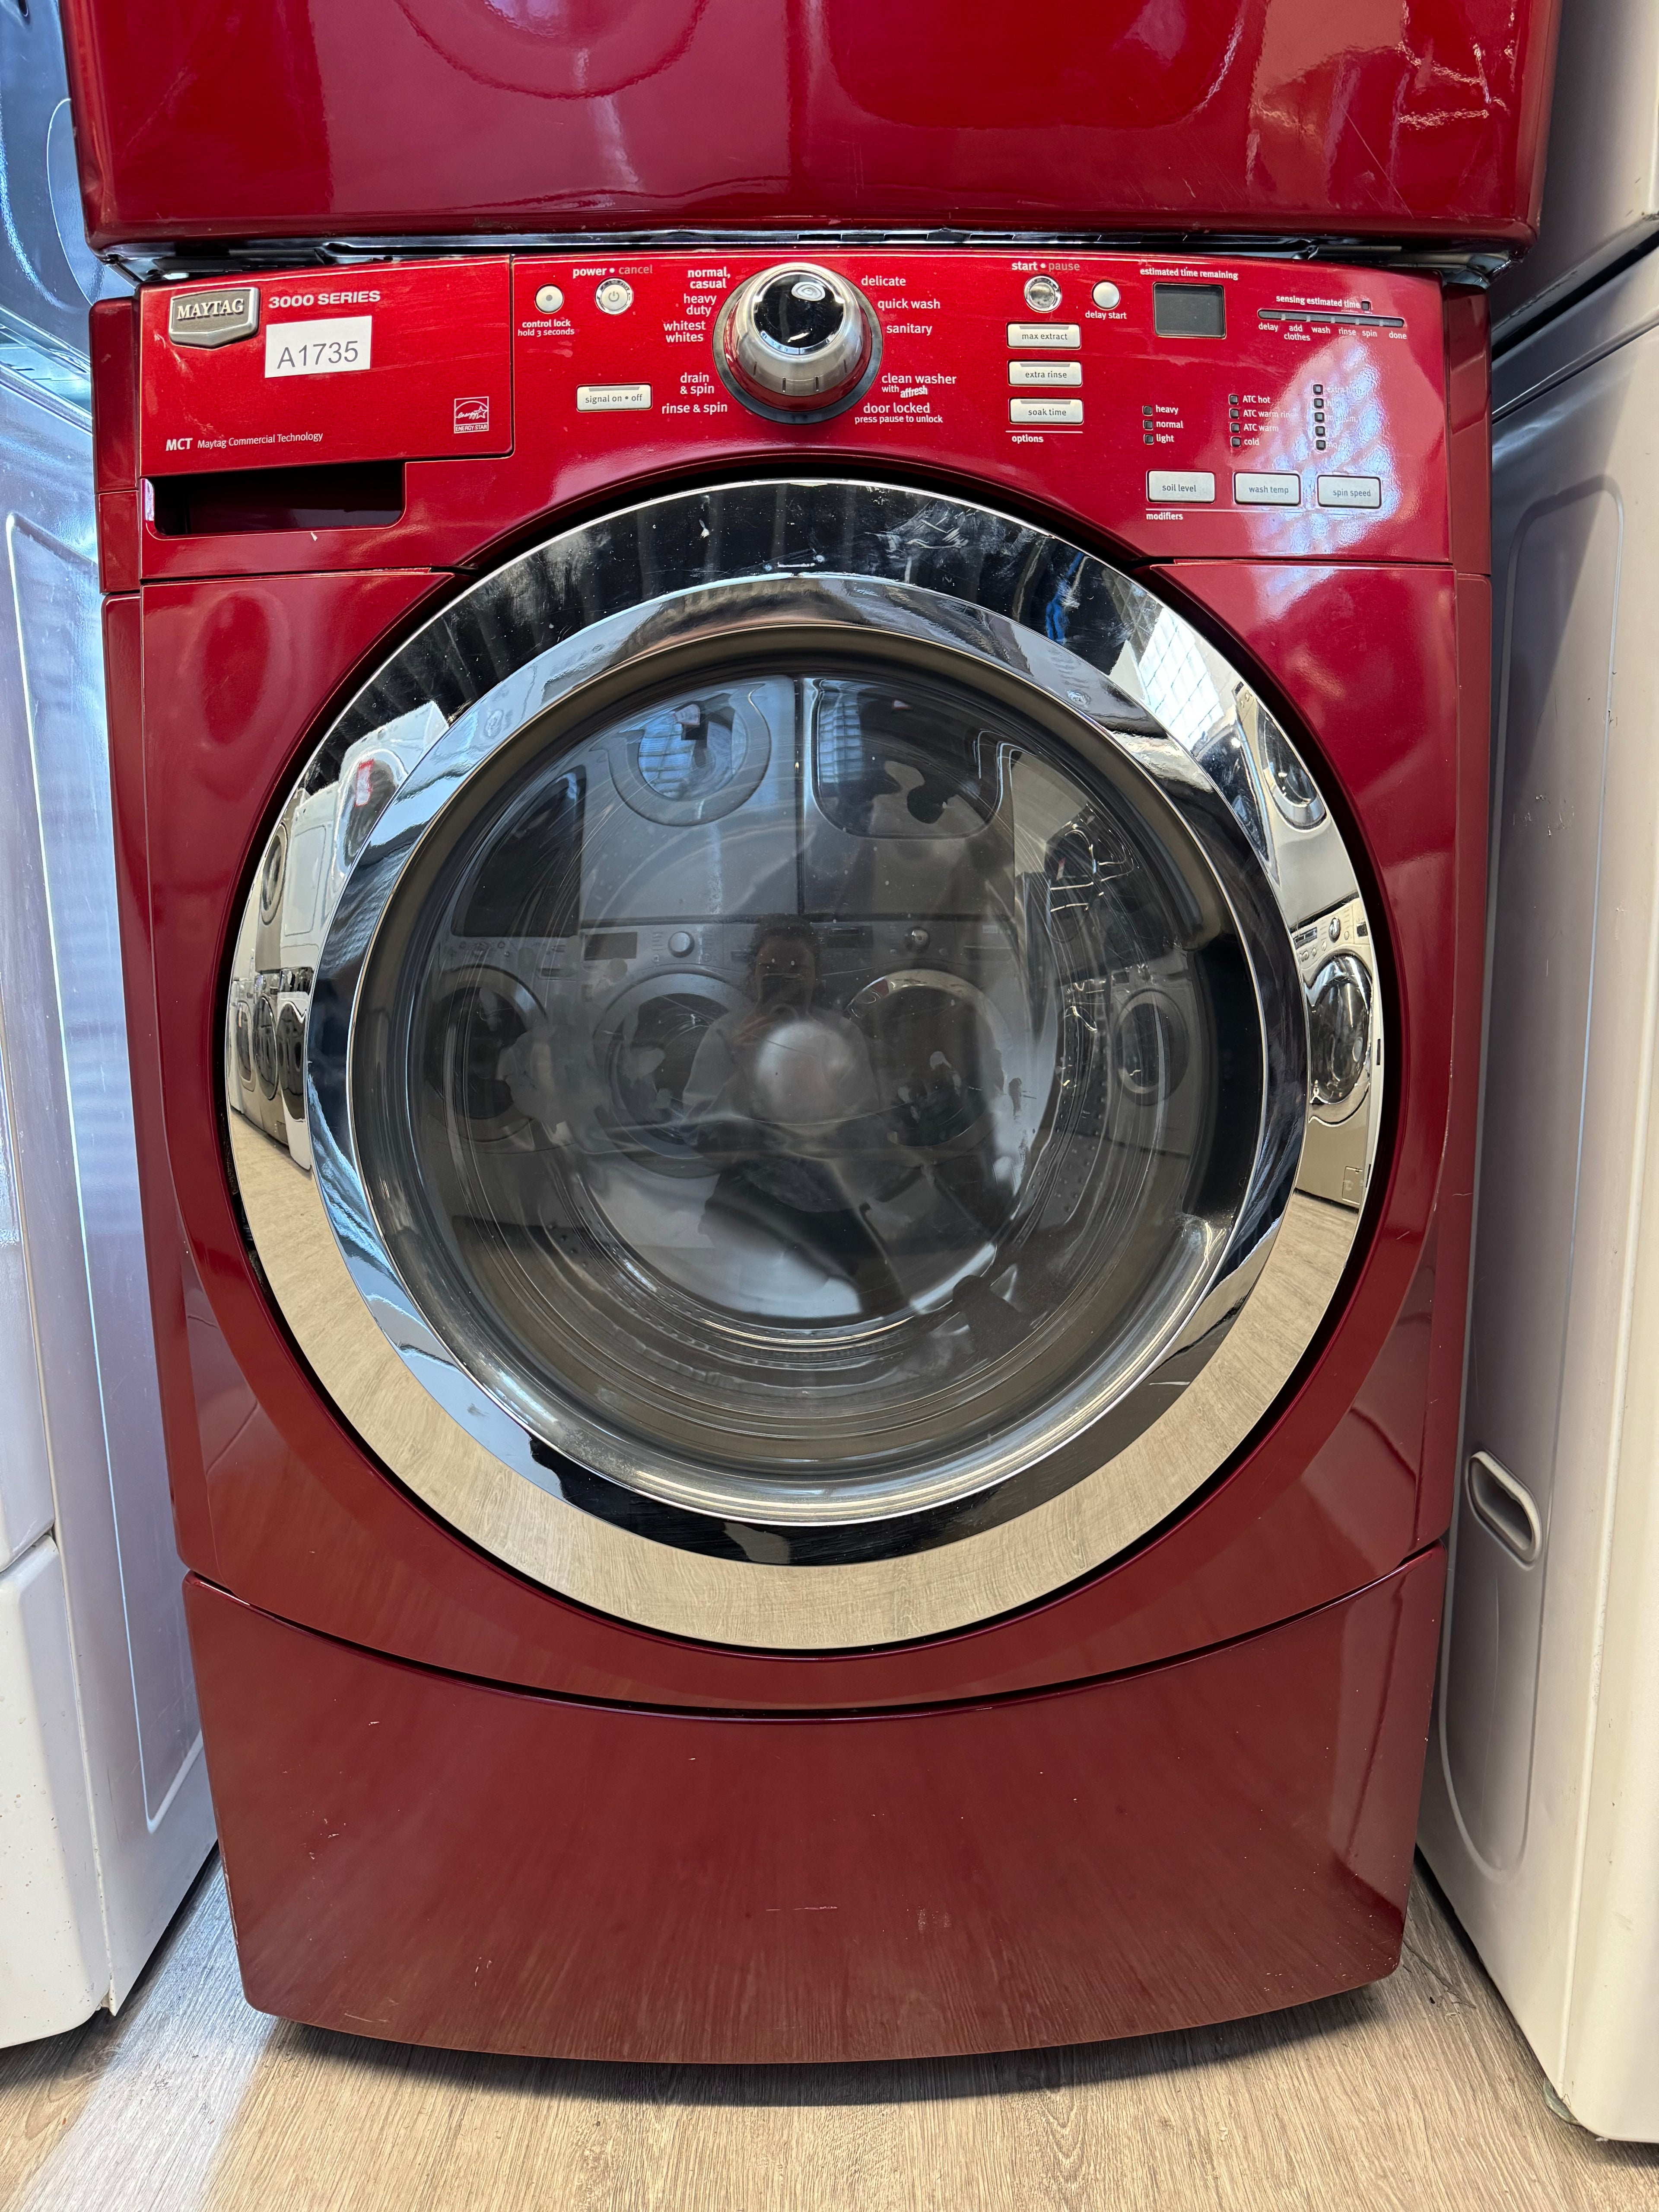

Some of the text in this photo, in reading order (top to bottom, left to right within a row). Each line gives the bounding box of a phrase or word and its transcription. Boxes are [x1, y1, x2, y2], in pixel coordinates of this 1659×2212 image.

[572, 264, 653, 279] power cancel
[687, 267, 731, 279] normal,
[1011, 262, 1080, 273] start pause
[1140, 267, 1238, 280] estimated time remaining
[690, 278, 727, 289] casual
[861, 275, 906, 286] delicate
[268, 290, 381, 308] 3000 SERIES
[683, 293, 717, 305] heavy
[1276, 295, 1360, 308] sensing estimated time
[177, 298, 244, 320] MAYTAG
[877, 299, 941, 311] quick wash
[686, 305, 712, 317] duty
[1085, 311, 1127, 320] delay start
[522, 319, 571, 328] control lock
[663, 320, 706, 331] whitest
[886, 323, 932, 335] sanitary
[1258, 322, 1278, 332] delay
[1311, 326, 1330, 334] wash
[1338, 327, 1356, 336] rinse
[1362, 330, 1377, 338] spin
[1389, 331, 1407, 339] done
[666, 332, 704, 343] whites
[1284, 332, 1310, 341] clothes
[277, 340, 358, 369] A1735
[680, 372, 709, 383] drain
[881, 373, 957, 385] clean washer
[680, 384, 715, 396] & spin
[882, 385, 928, 398] with affresh
[585, 394, 610, 404] signal
[662, 402, 728, 415] rinse & spin
[863, 403, 930, 414] door locked
[1028, 408, 1047, 416] soak
[1155, 406, 1179, 415] heavy
[855, 416, 877, 425] press
[879, 416, 904, 425] pause
[916, 415, 943, 423] unlock
[1156, 420, 1183, 429] normal
[165, 432, 323, 451] MCT Maytag Commercial Technology
[1011, 435, 1043, 444] options
[1156, 434, 1174, 444] light
[1162, 483, 1196, 492] soil level
[1270, 486, 1289, 495] temp
[1332, 488, 1371, 498] spin speed
